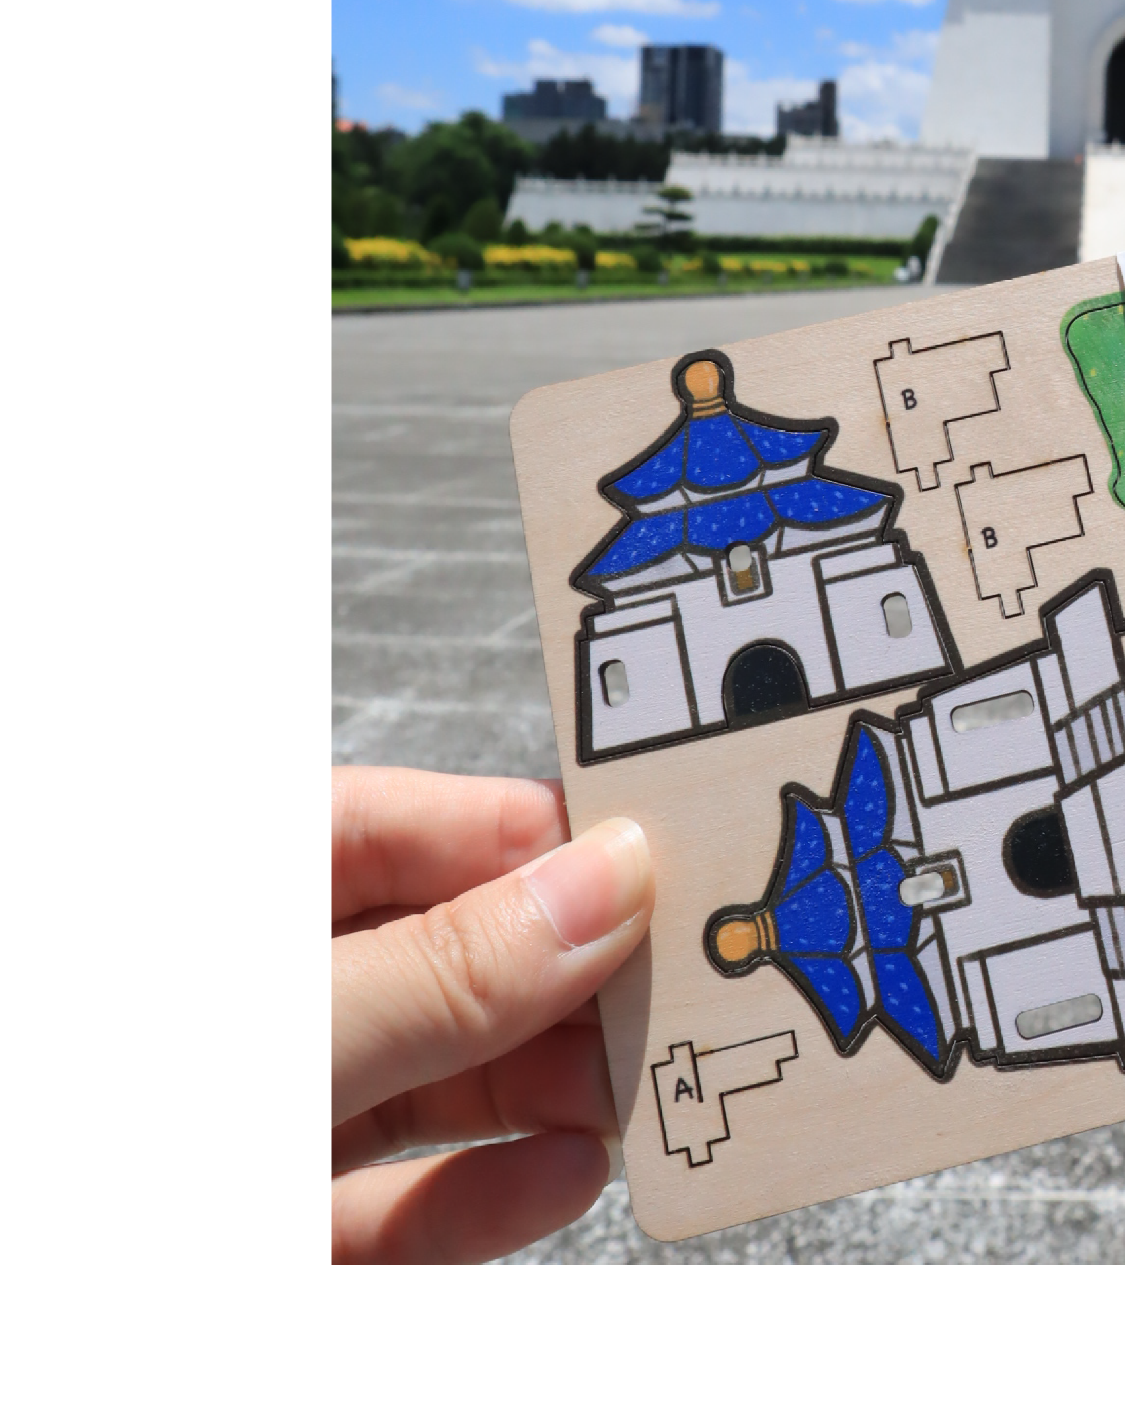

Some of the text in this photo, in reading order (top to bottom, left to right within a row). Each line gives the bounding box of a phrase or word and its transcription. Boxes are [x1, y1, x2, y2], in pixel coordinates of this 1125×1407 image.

[901, 388, 918, 410] B
[980, 526, 999, 549] B
[673, 1077, 694, 1103] A
